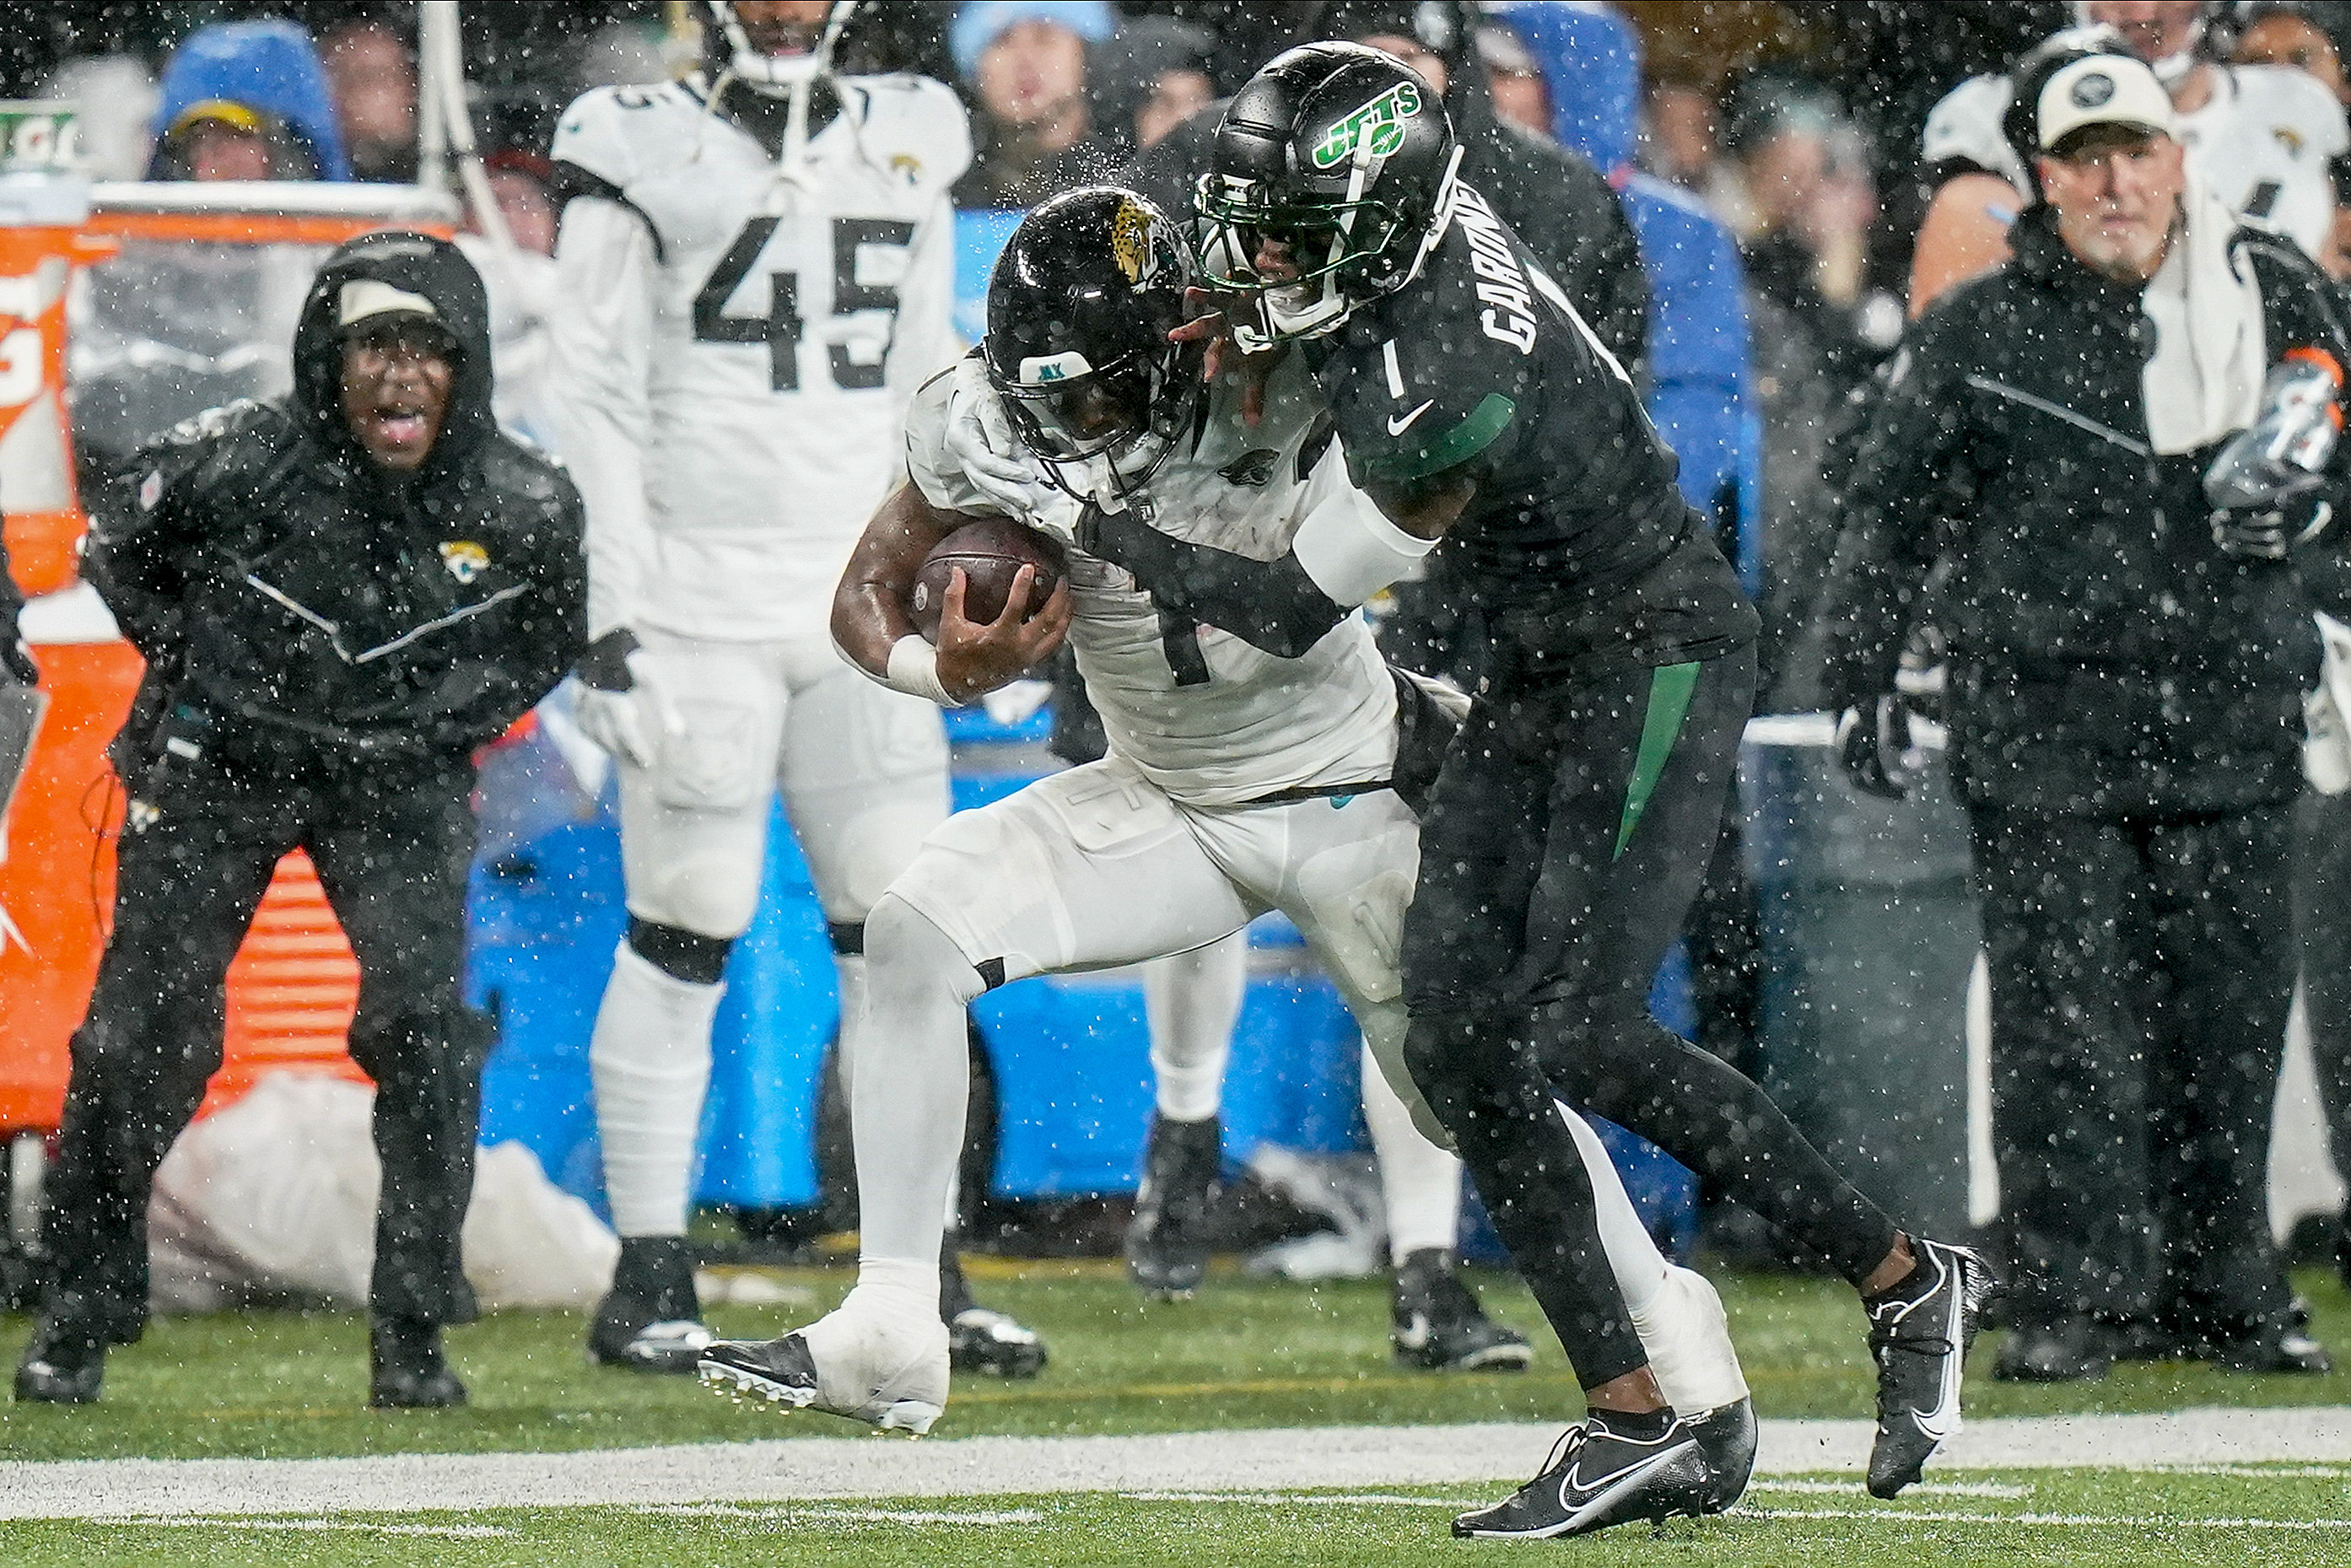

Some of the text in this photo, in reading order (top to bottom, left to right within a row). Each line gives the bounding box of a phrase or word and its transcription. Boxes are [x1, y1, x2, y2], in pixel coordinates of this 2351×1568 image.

[1312, 81, 1422, 169] JETS
[691, 215, 915, 391] 45
[1453, 177, 1537, 355] GARDNE
[1383, 339, 1405, 399] 1
